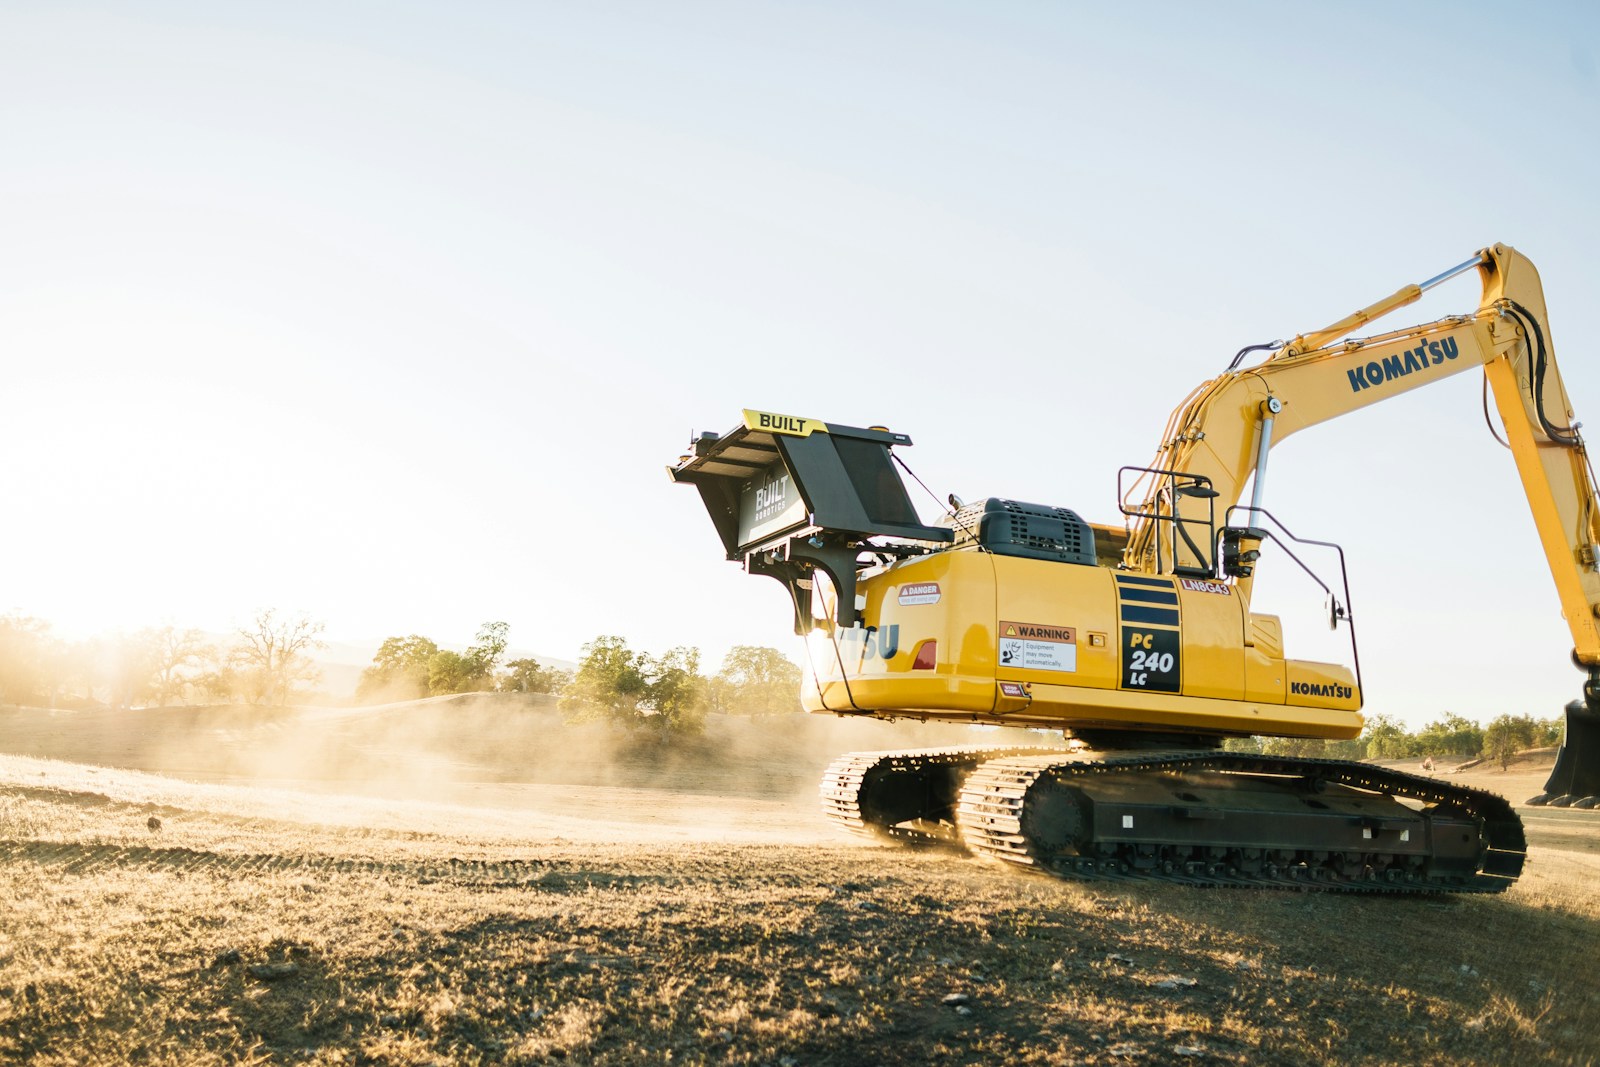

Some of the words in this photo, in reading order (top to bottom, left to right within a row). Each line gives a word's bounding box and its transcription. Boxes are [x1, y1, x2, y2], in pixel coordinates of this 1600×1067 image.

[1346, 336, 1459, 392] KOMATSU
[759, 413, 807, 432] BUILT
[755, 475, 789, 512] BUILT
[755, 500, 786, 521] ROBOTICS
[908, 585, 937, 595] DANGER
[1181, 579, 1230, 595] LN8G43
[1019, 626, 1070, 640] WARNING
[1130, 633, 1154, 649] PC
[1026, 642, 1055, 651] Equipment
[1129, 650, 1174, 673] 240
[1129, 672, 1148, 686] LC
[1291, 682, 1352, 699] KOMATSU
